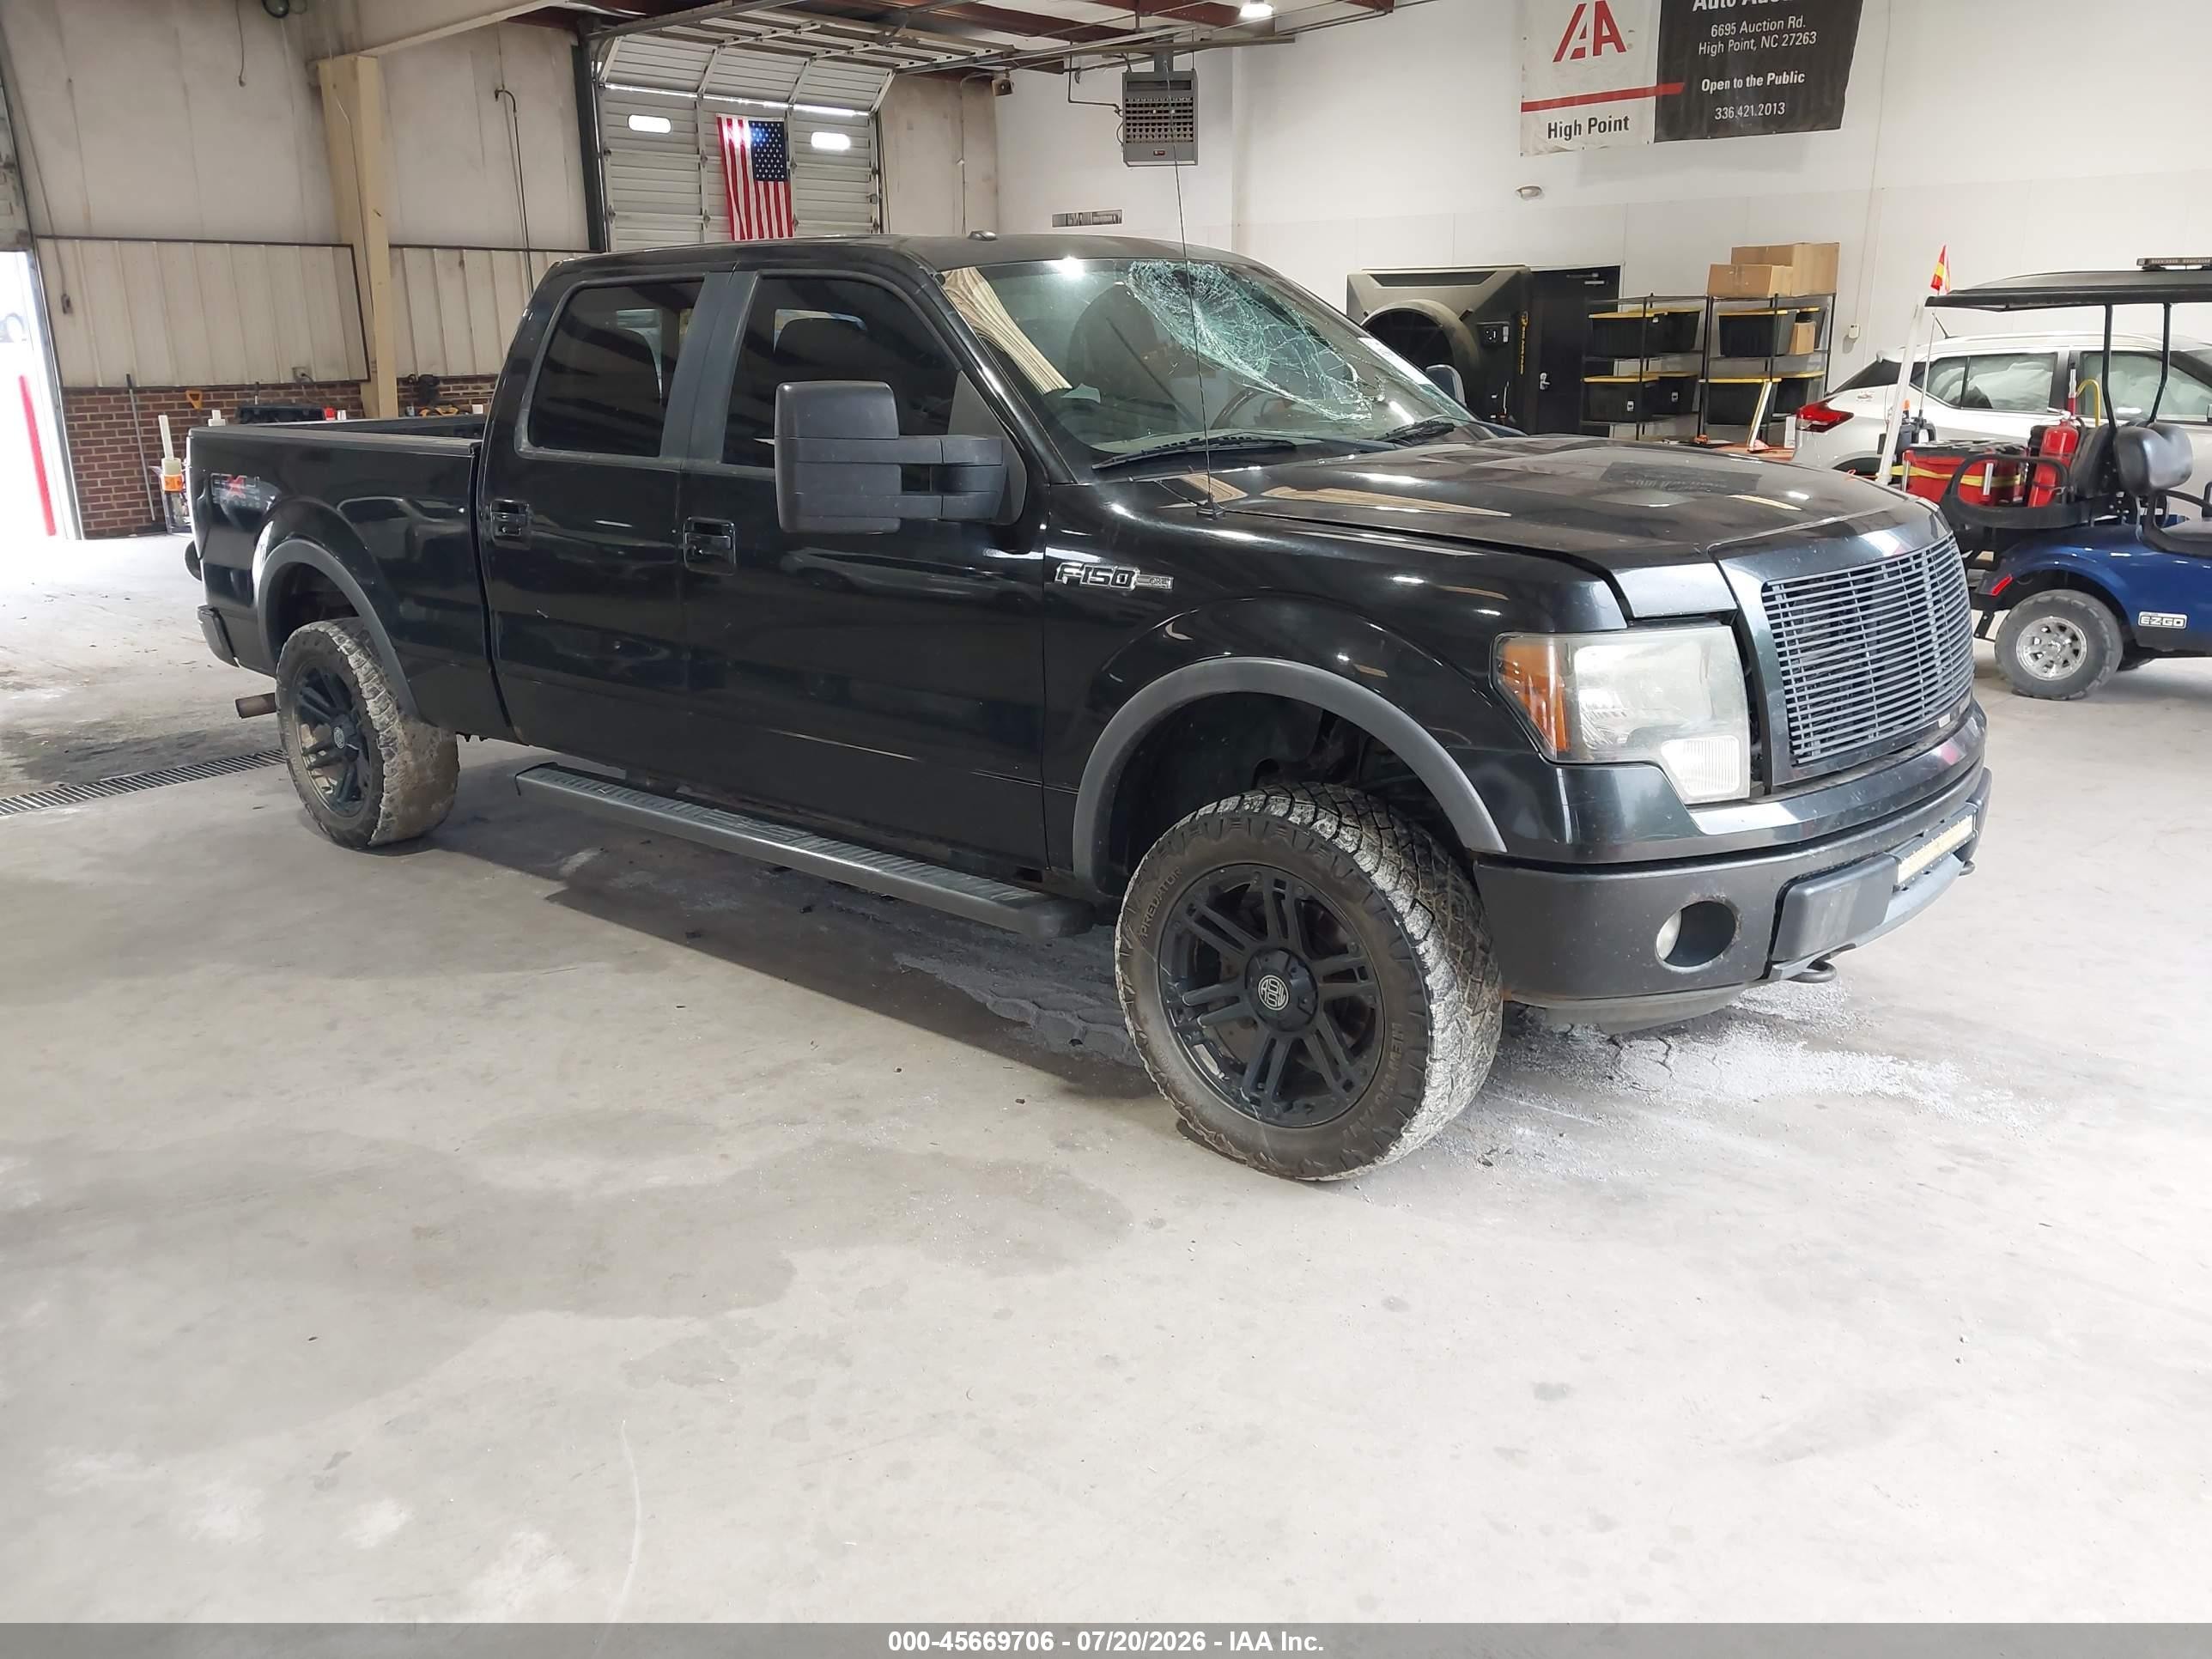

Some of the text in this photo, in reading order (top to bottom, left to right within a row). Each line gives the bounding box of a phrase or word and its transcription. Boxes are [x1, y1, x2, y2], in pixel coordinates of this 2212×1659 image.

[1711, 15, 1806, 38] 6695 Auction Rd.
[1698, 31, 1817, 57] High Point, NC 27263
[1701, 70, 1805, 94] Open to the Public
[1714, 102, 1785, 120] 336.421.2013
[1547, 115, 1630, 141] High Point
[1139, 866, 1182, 939] PREDATOR
